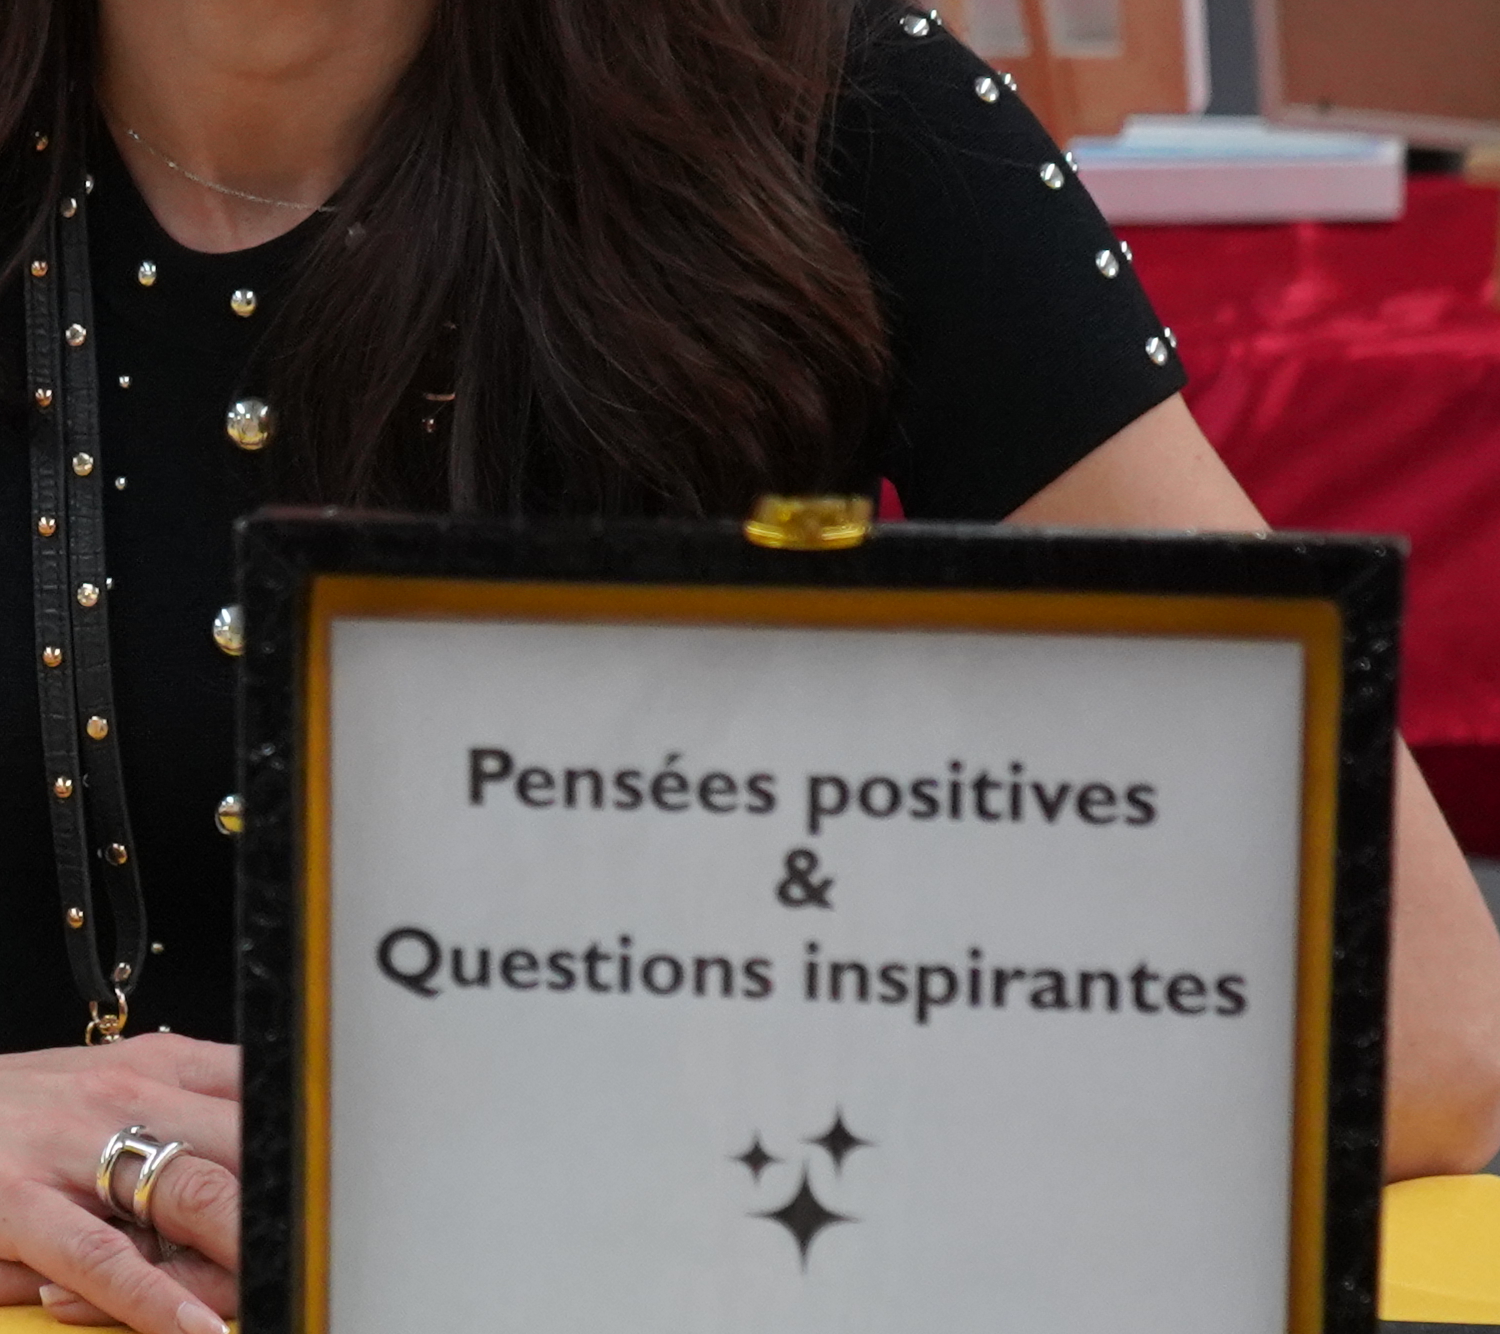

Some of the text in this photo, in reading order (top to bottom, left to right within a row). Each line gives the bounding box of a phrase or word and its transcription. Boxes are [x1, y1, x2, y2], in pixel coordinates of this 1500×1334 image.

[465, 745, 1160, 834] Pensées positives
[773, 847, 837, 911] &
[375, 925, 1250, 1026] Questions inspirantes
